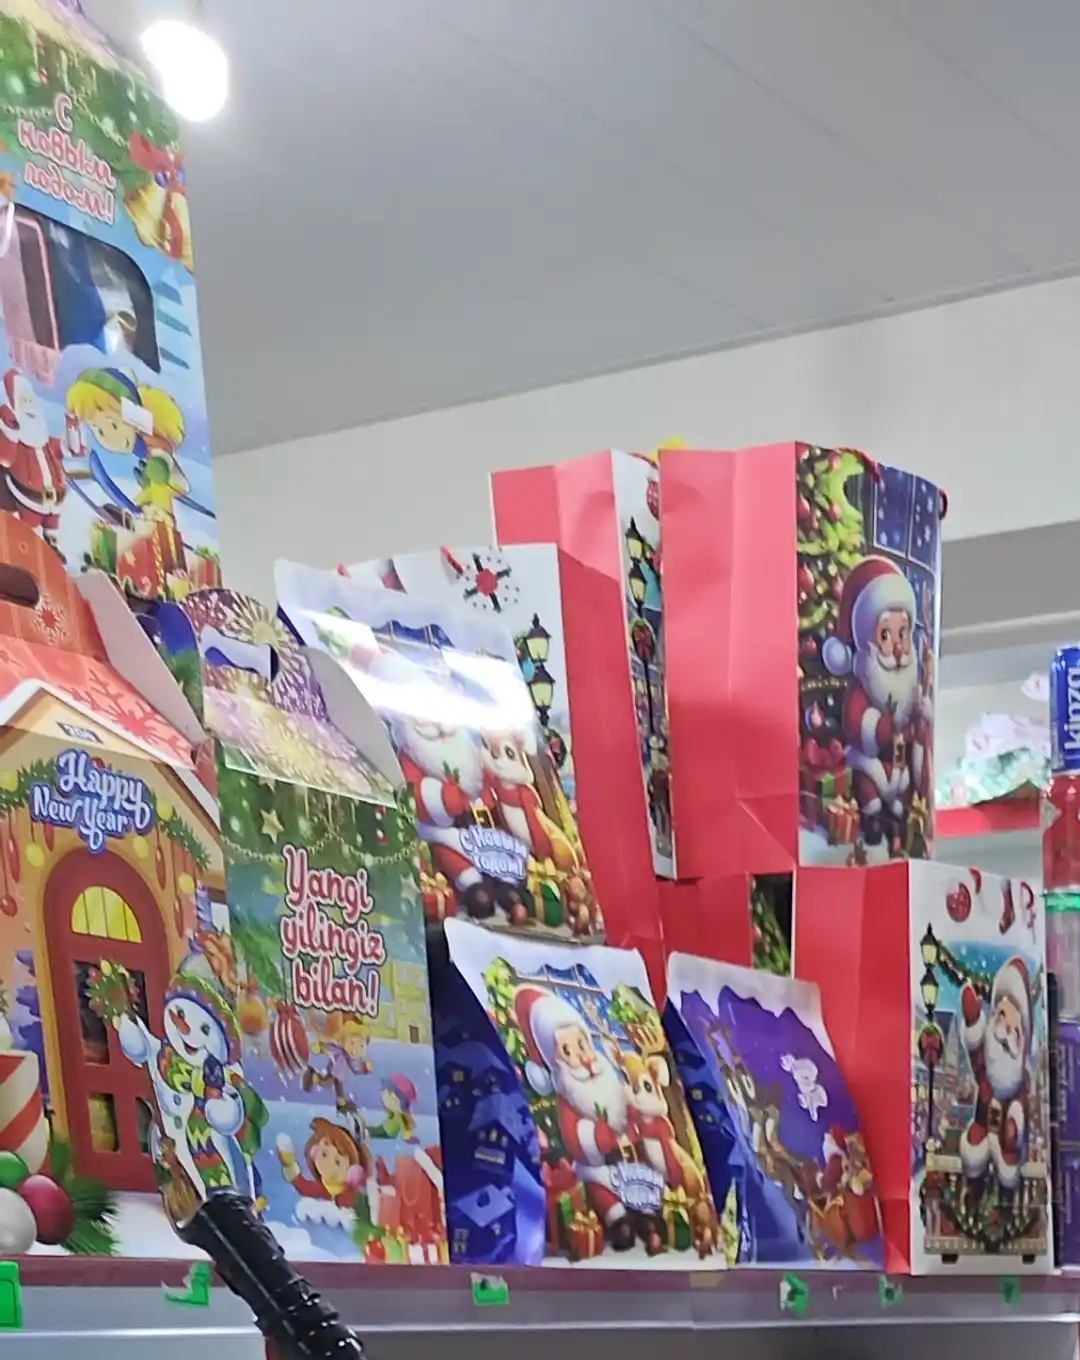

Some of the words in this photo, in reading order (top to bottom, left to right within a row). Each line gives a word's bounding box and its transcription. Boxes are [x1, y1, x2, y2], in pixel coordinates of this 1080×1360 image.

[33, 785, 83, 823] New
[79, 797, 129, 850] Year
[58, 750, 151, 830] Happy
[284, 846, 372, 922] Yangi
[282, 902, 385, 973] yilingiz
[293, 954, 380, 1017] bilan!
